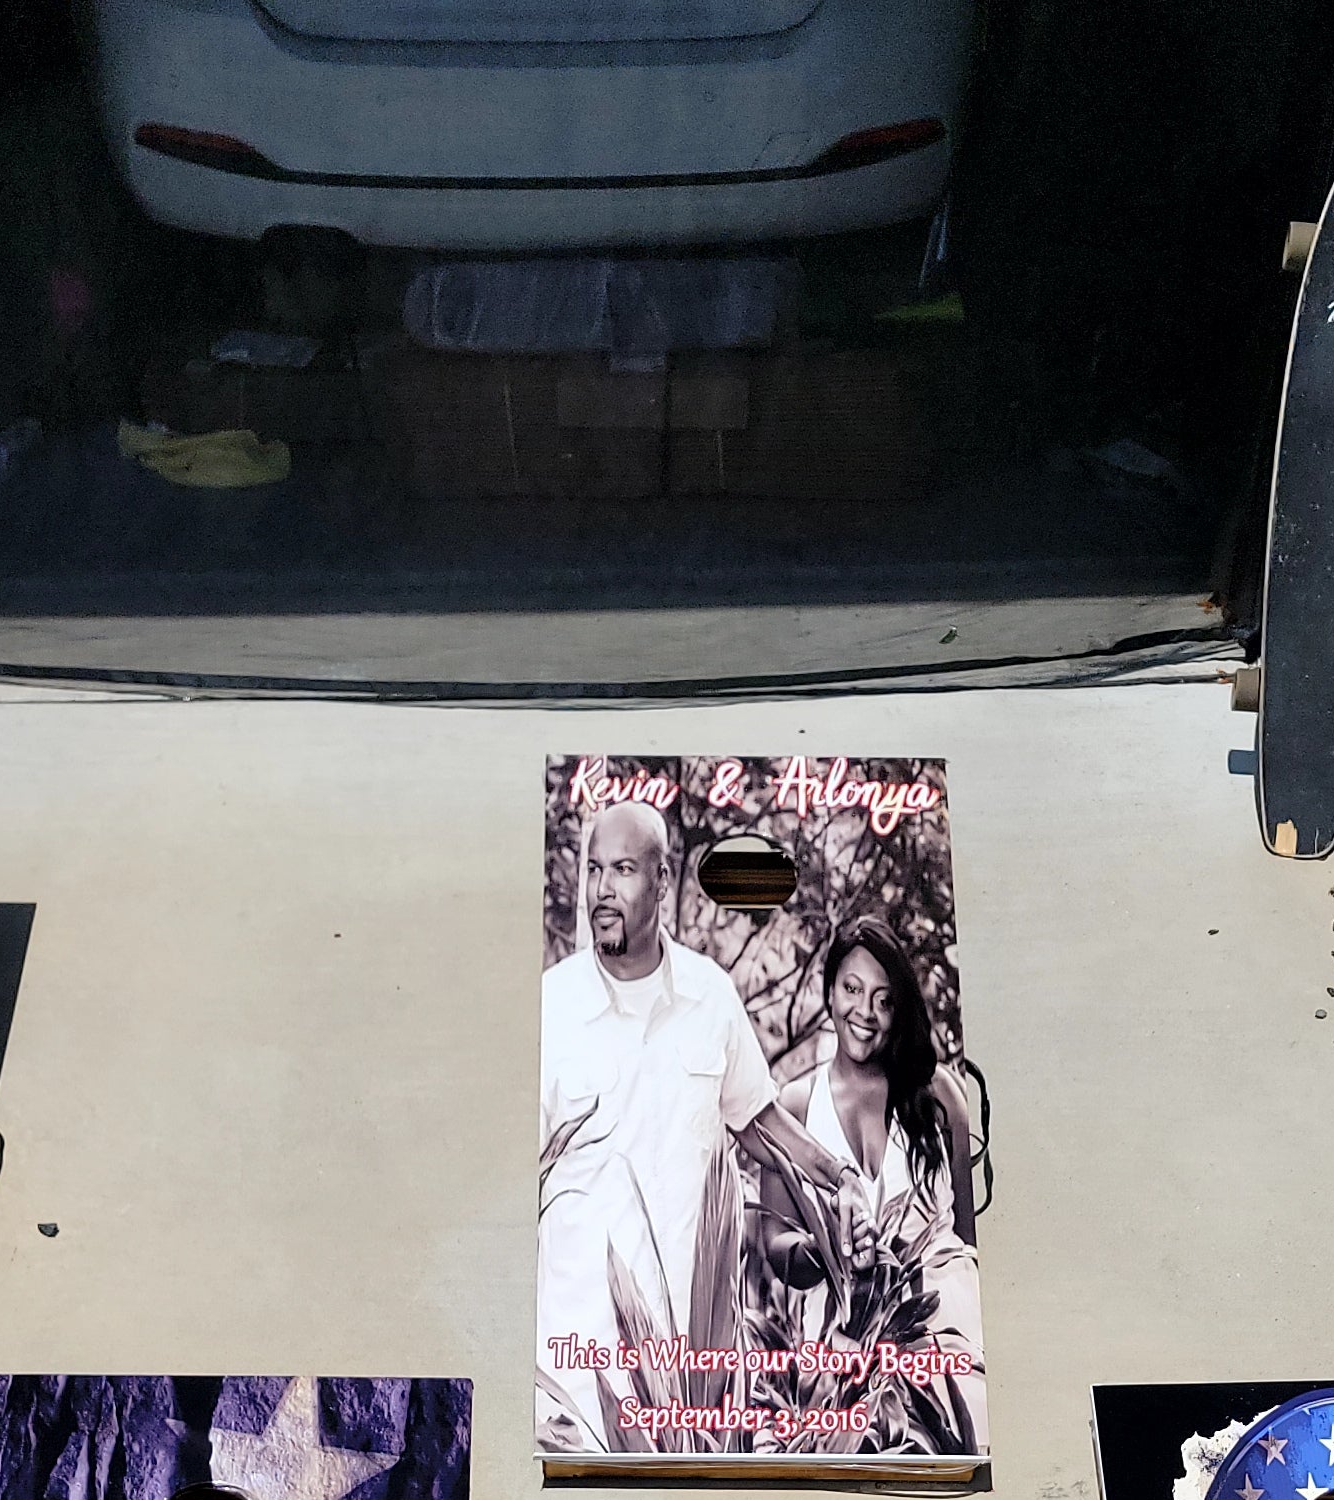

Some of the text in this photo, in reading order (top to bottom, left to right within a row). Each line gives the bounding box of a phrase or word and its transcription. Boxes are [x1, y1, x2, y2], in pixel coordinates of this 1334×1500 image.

[569, 755, 941, 836] Kevin & Arlonya
[548, 1333, 972, 1386] This is Where our Story Begins
[618, 1394, 869, 1440] September 3, 2016
